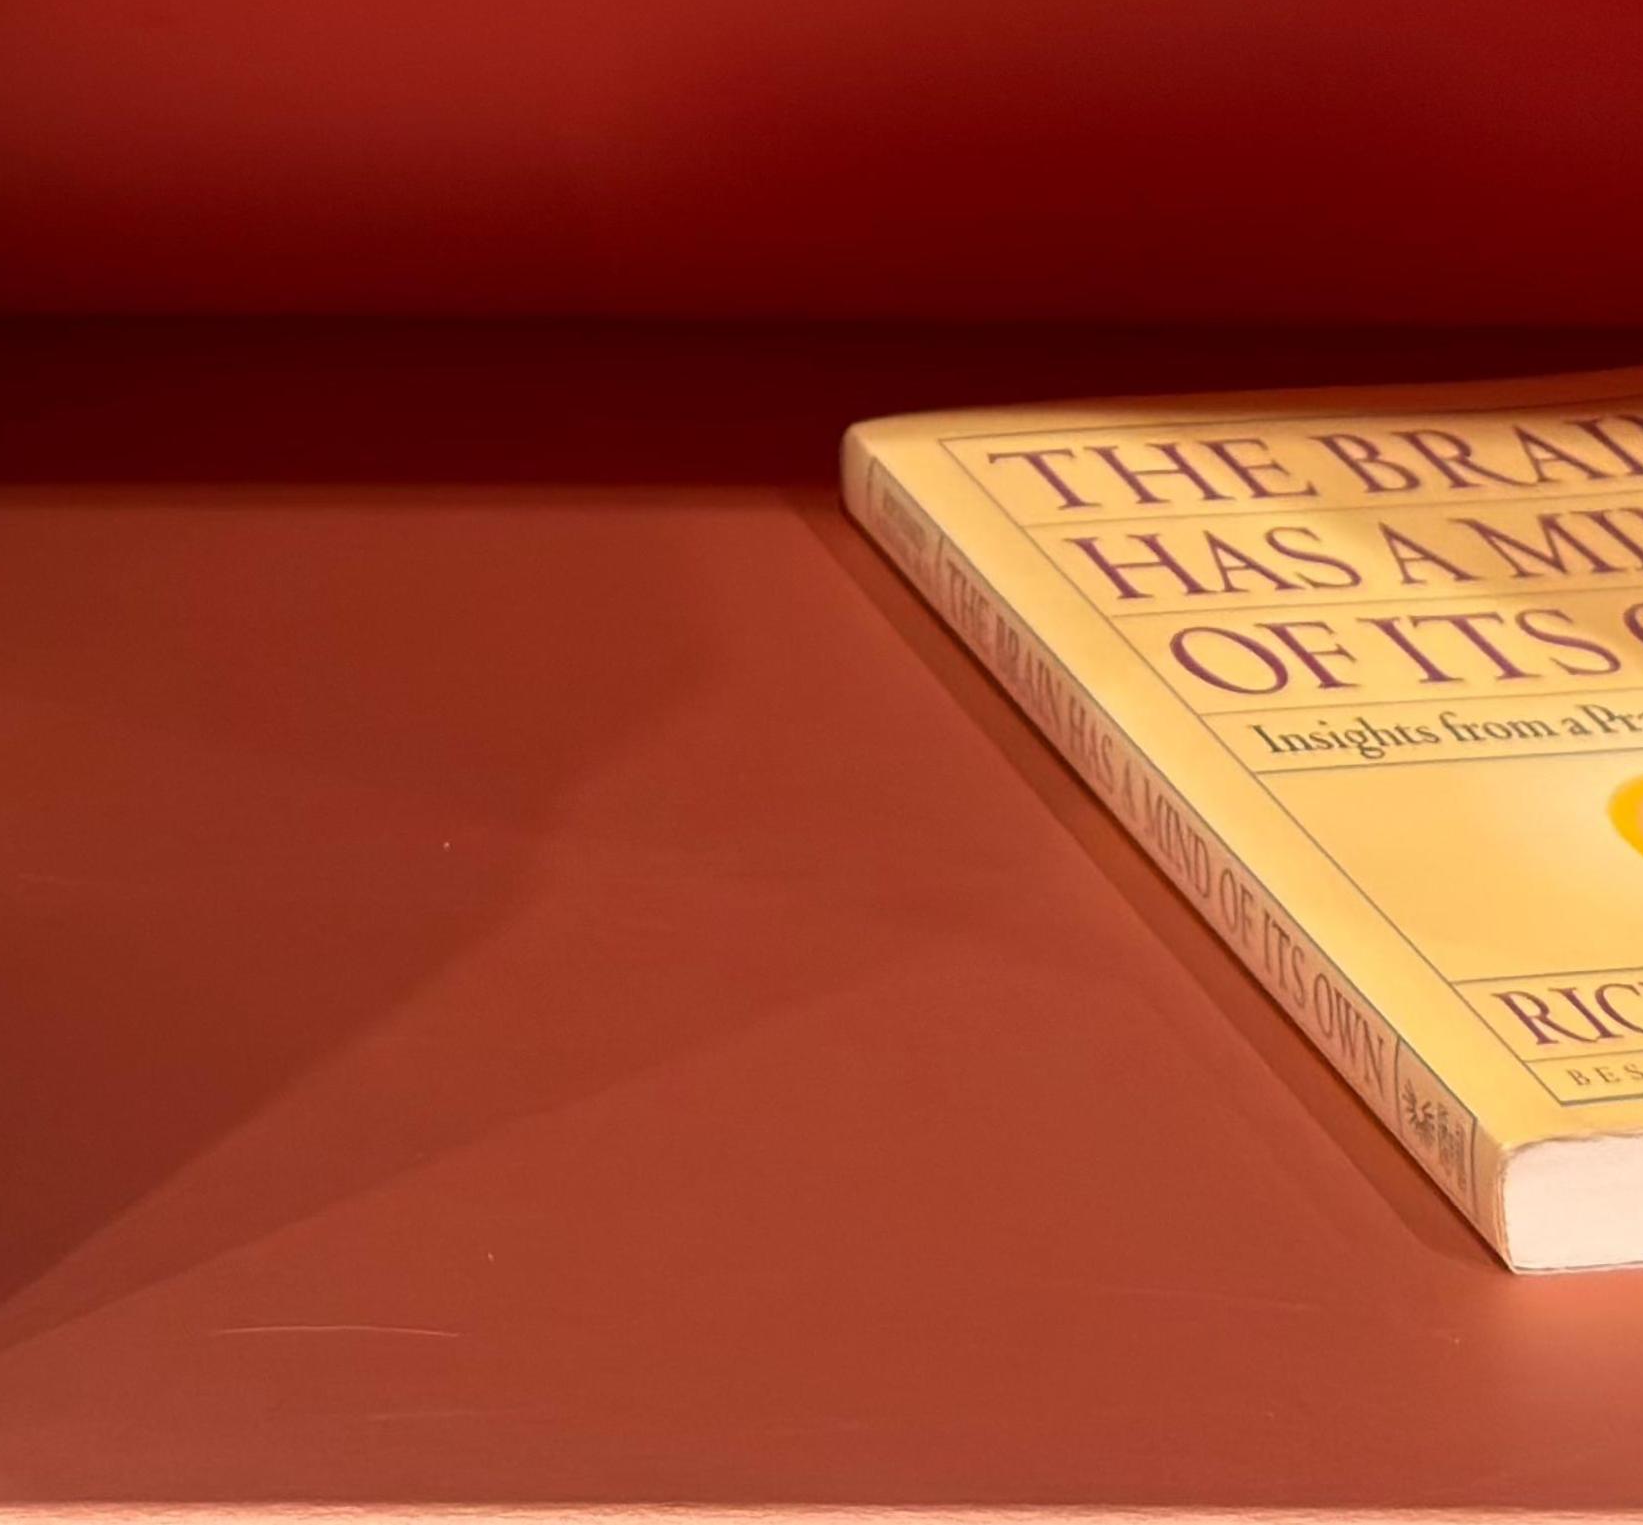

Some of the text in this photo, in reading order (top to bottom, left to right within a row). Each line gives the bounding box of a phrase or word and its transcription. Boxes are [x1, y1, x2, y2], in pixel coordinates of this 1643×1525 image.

[987, 437, 1316, 512] THE
[1062, 525, 1363, 602] HAS
[1376, 521, 1474, 588] A
[1168, 618, 1360, 695] OF
[1357, 607, 1622, 683] ITS
[1251, 715, 1442, 758] Insights
[1443, 705, 1556, 744] from
[1567, 714, 1589, 736] a
[1068, 695, 1113, 794] HAS
[1144, 778, 1211, 898] MIND
[1219, 868, 1253, 949] OF
[1264, 910, 1306, 1008] ITS
[1314, 973, 1384, 1098] OWN
